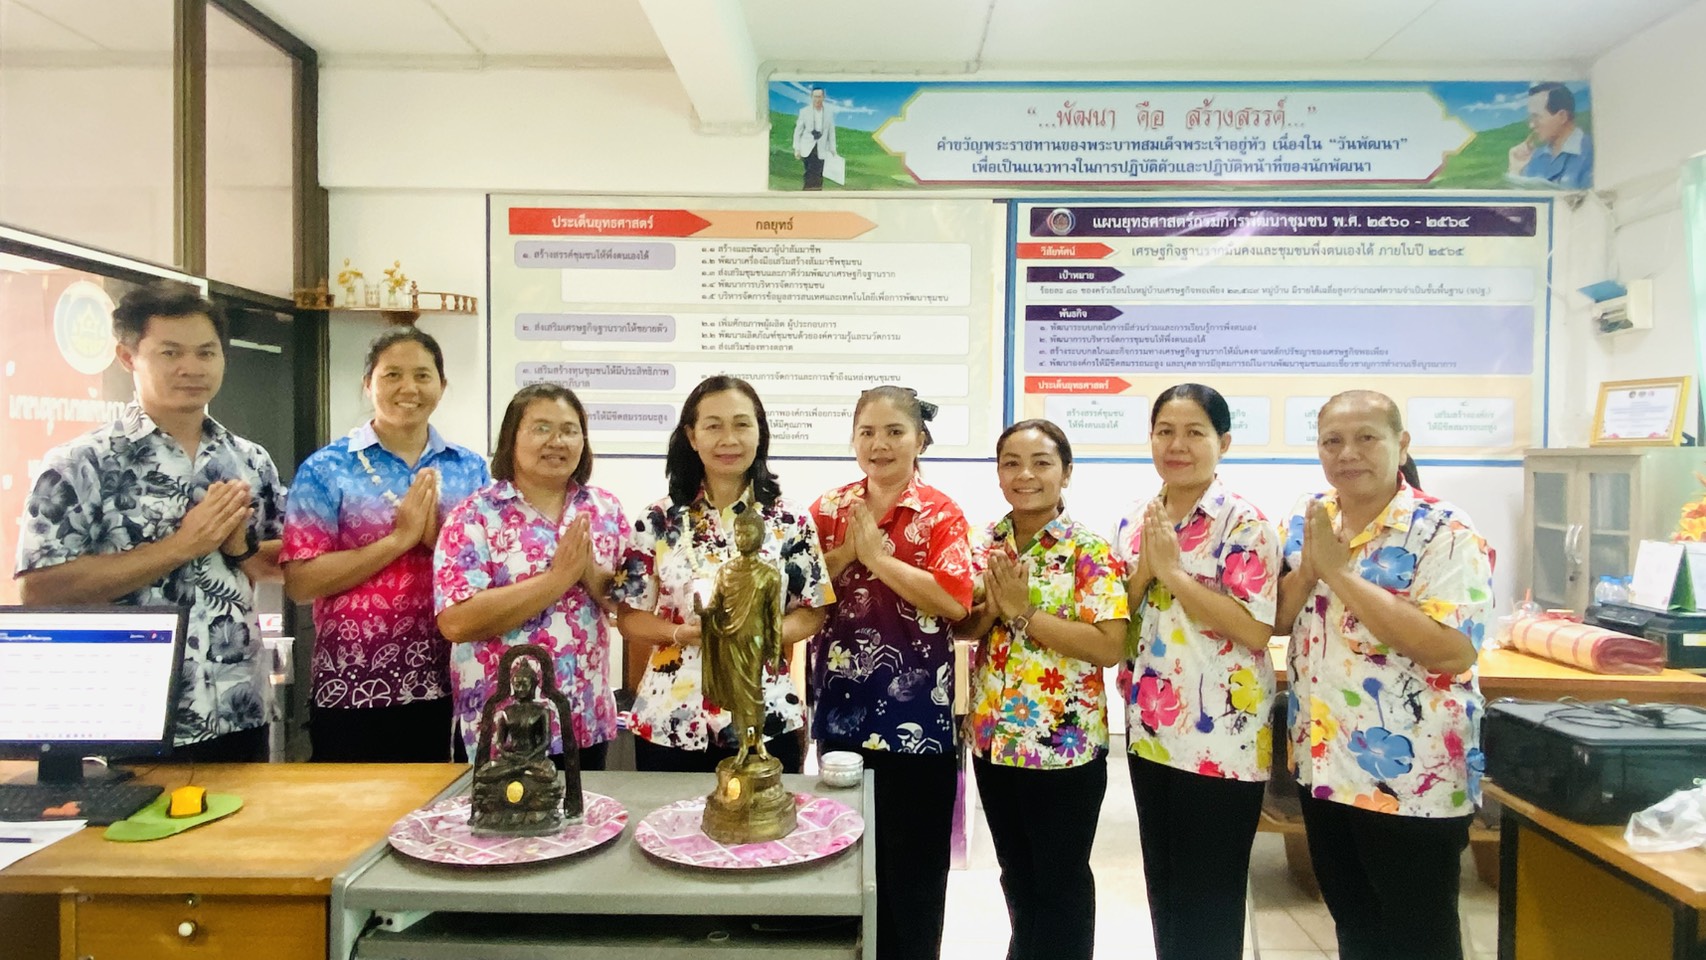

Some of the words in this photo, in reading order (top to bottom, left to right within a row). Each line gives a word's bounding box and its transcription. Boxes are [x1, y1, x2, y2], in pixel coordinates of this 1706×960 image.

[1272, 133, 1322, 151] เนื่องใน
[551, 213, 654, 233] ประเด็นยุทธศาสตร์
[755, 217, 794, 234] กลยุทธ์
[1332, 215, 1362, 228] พ.ศ.
[1040, 246, 1076, 257] วิสัยทัศน์
[1378, 243, 1424, 257] ภายในปี
[1058, 269, 1095, 281] เป้าหมาย
[1058, 307, 1088, 319] พันธกิจ
[1037, 378, 1110, 392] ประเด็นยุทธศาสตร์
